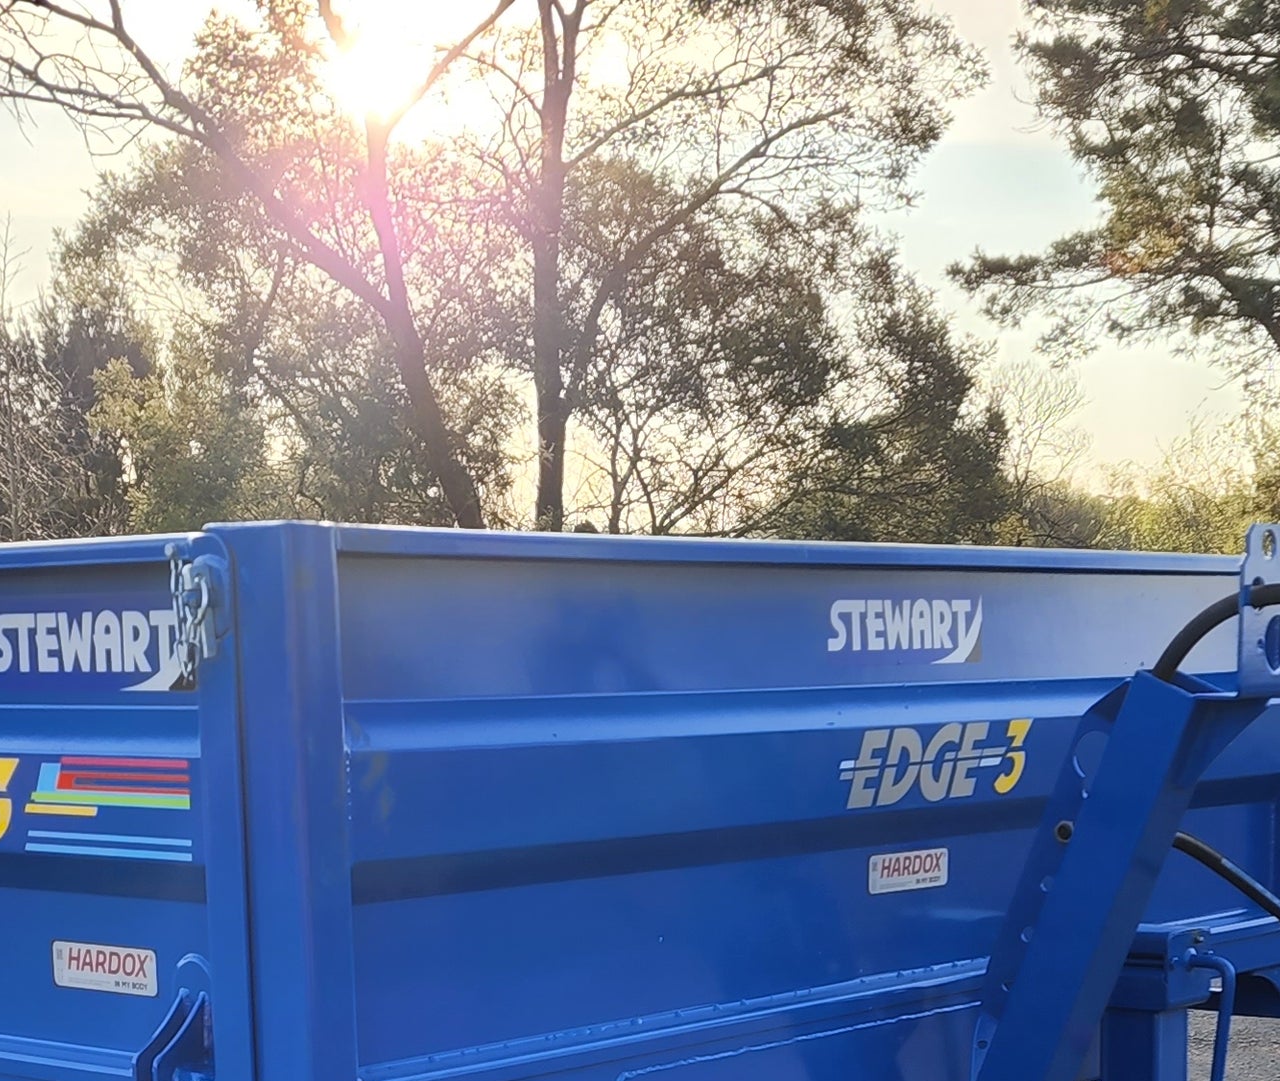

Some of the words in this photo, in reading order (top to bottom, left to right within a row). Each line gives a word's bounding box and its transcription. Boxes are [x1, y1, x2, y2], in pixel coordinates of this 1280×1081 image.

[828, 595, 983, 664] STEWART
[880, 852, 943, 879] HARDOX
[68, 947, 148, 979] HARDOX
